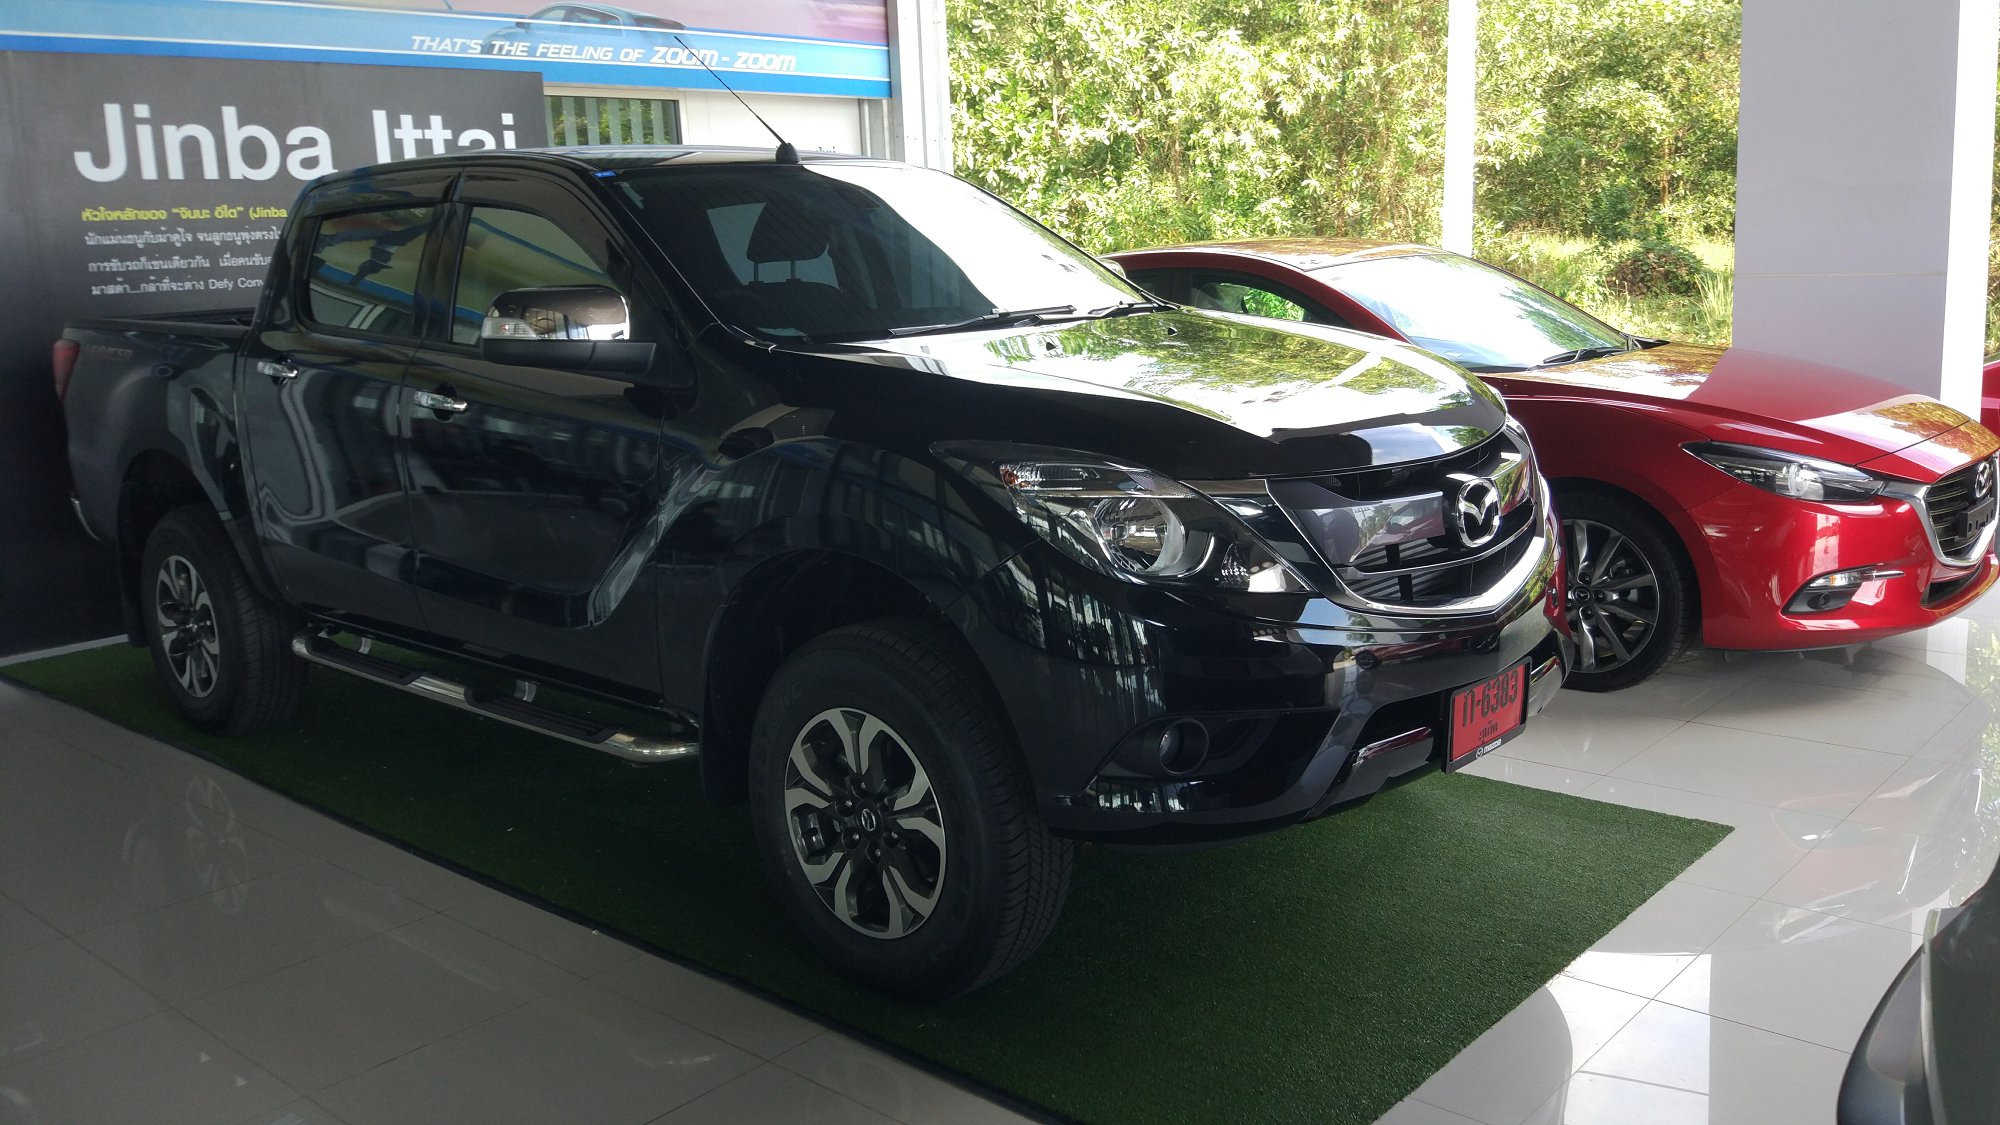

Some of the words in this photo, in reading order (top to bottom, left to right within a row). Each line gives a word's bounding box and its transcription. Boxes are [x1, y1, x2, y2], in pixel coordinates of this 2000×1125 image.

[411, 36, 483, 54] THAT'S
[491, 40, 531, 56] THE
[536, 43, 613, 61] FEELING
[620, 48, 646, 62] OF
[74, 102, 339, 183] Jinba
[249, 206, 289, 220] (Jinba
[208, 278, 234, 291] Defy
